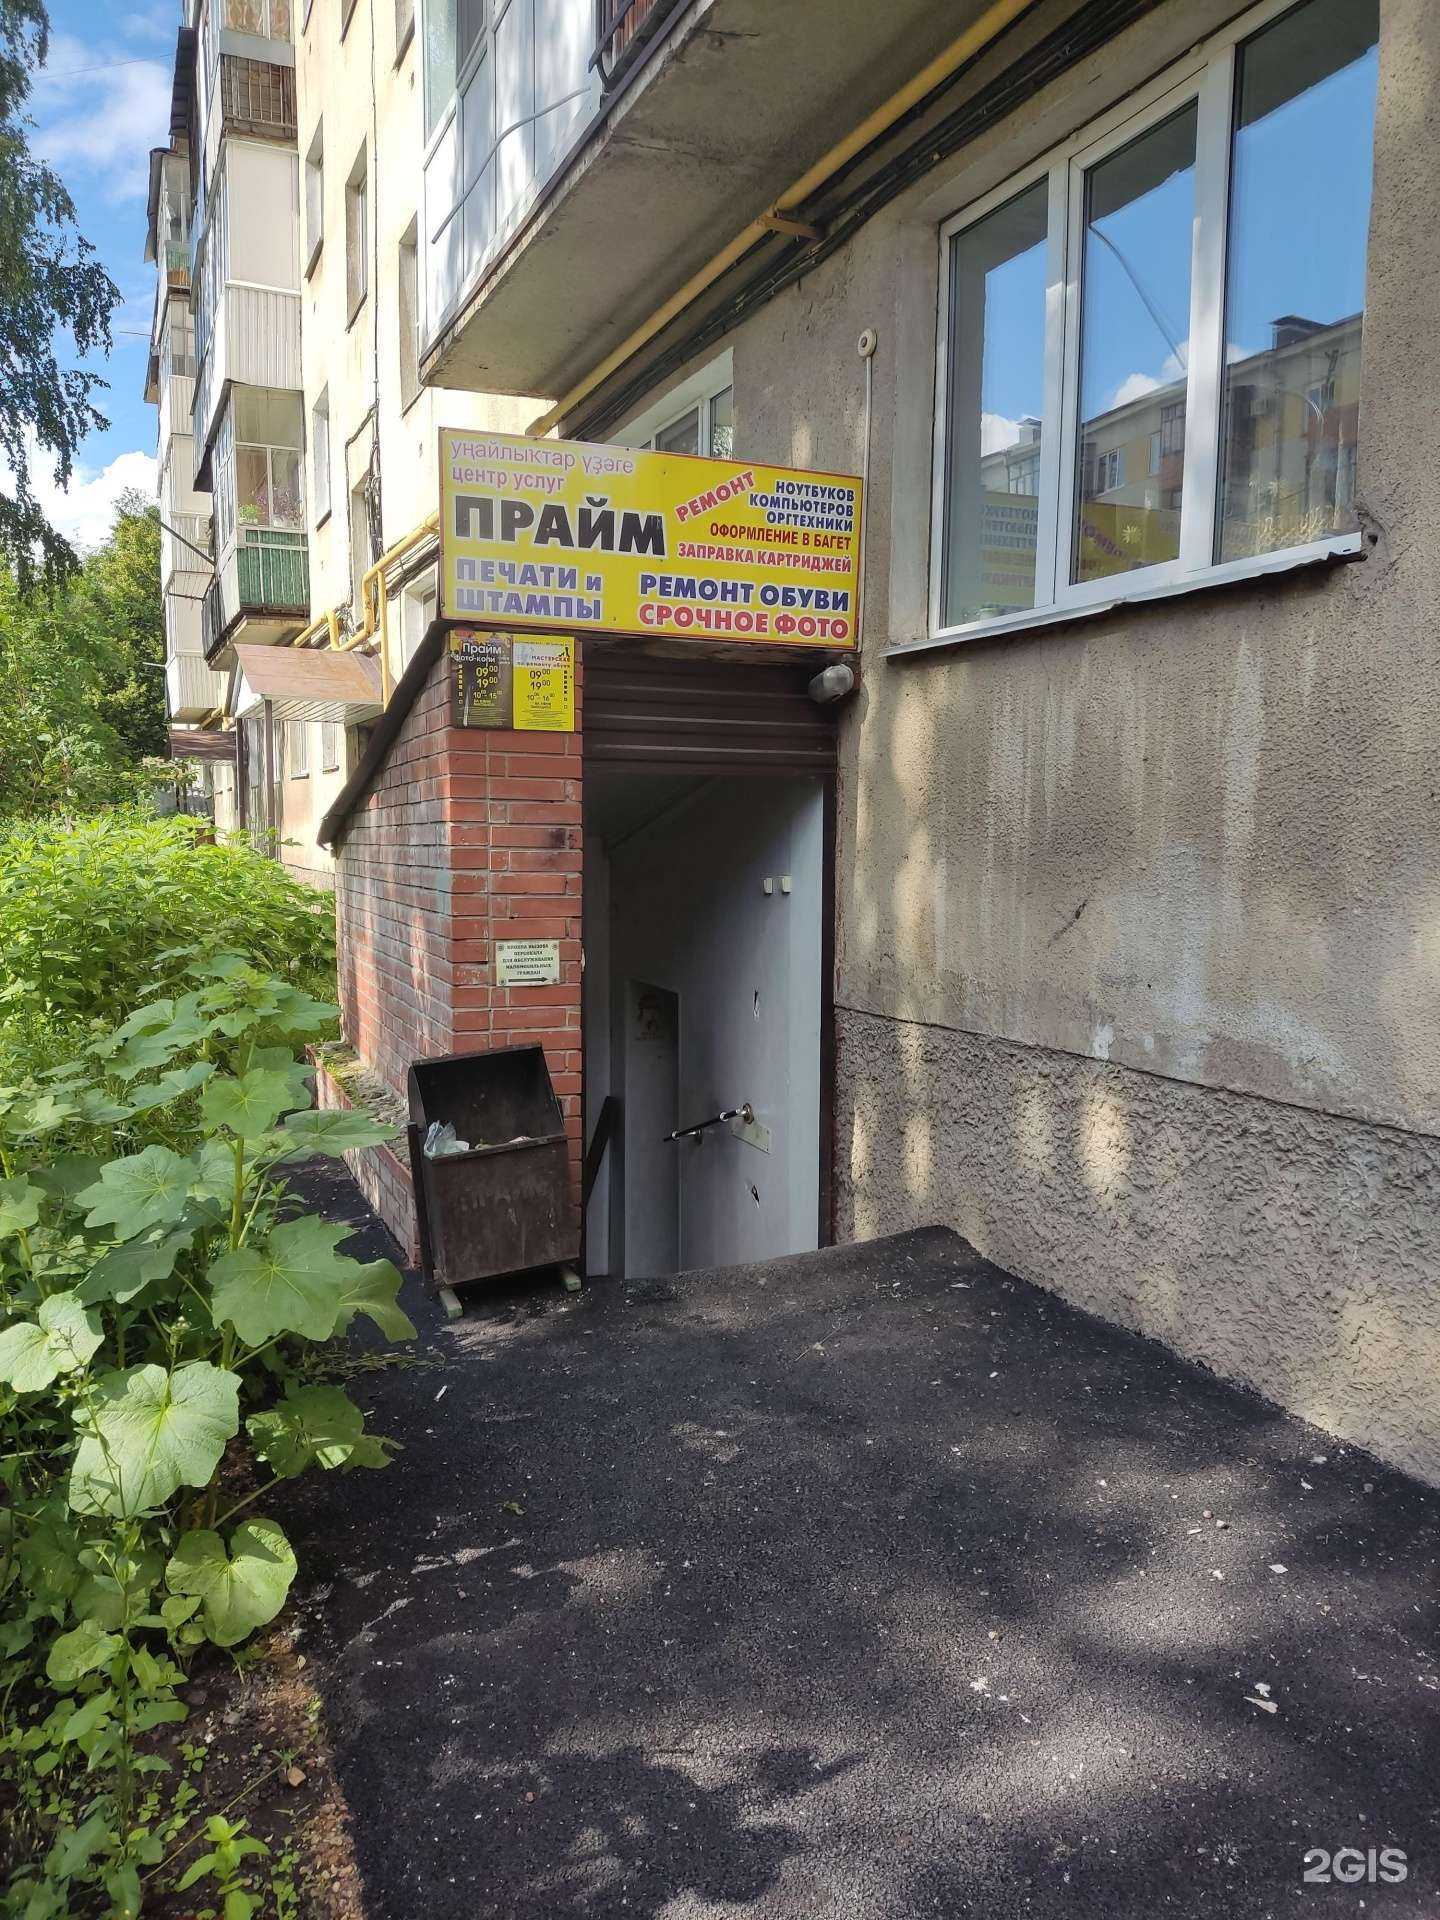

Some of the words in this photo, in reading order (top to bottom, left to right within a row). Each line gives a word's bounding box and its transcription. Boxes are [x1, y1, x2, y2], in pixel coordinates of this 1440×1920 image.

[452, 466, 507, 488] центр
[514, 471, 565, 494] услуг
[775, 480, 855, 502] НОУТБУКОВ
[674, 471, 755, 522] РЕМОНТ
[749, 494, 854, 517] КОМПЬЮТЕРОВ
[455, 495, 665, 556] ПРАЙМ
[710, 522, 798, 545] ОФОРМЛЕНИЕ
[802, 533, 810, 545] В
[814, 534, 851, 550] БАГЕТ
[766, 512, 853, 532] ОРГТЕХНИКИ
[678, 542, 754, 563] ЗАПРАВКА
[757, 550, 851, 573] КАРТРИДЖЕЙ
[456, 558, 577, 589] ПЕЧАТИ
[456, 589, 601, 620] ШТАМПЫ
[641, 574, 754, 603] РЕМОНТ
[760, 585, 849, 611] ОБУВИ
[639, 603, 769, 633] СРОЧНОЕ
[774, 613, 849, 639] ФОТО
